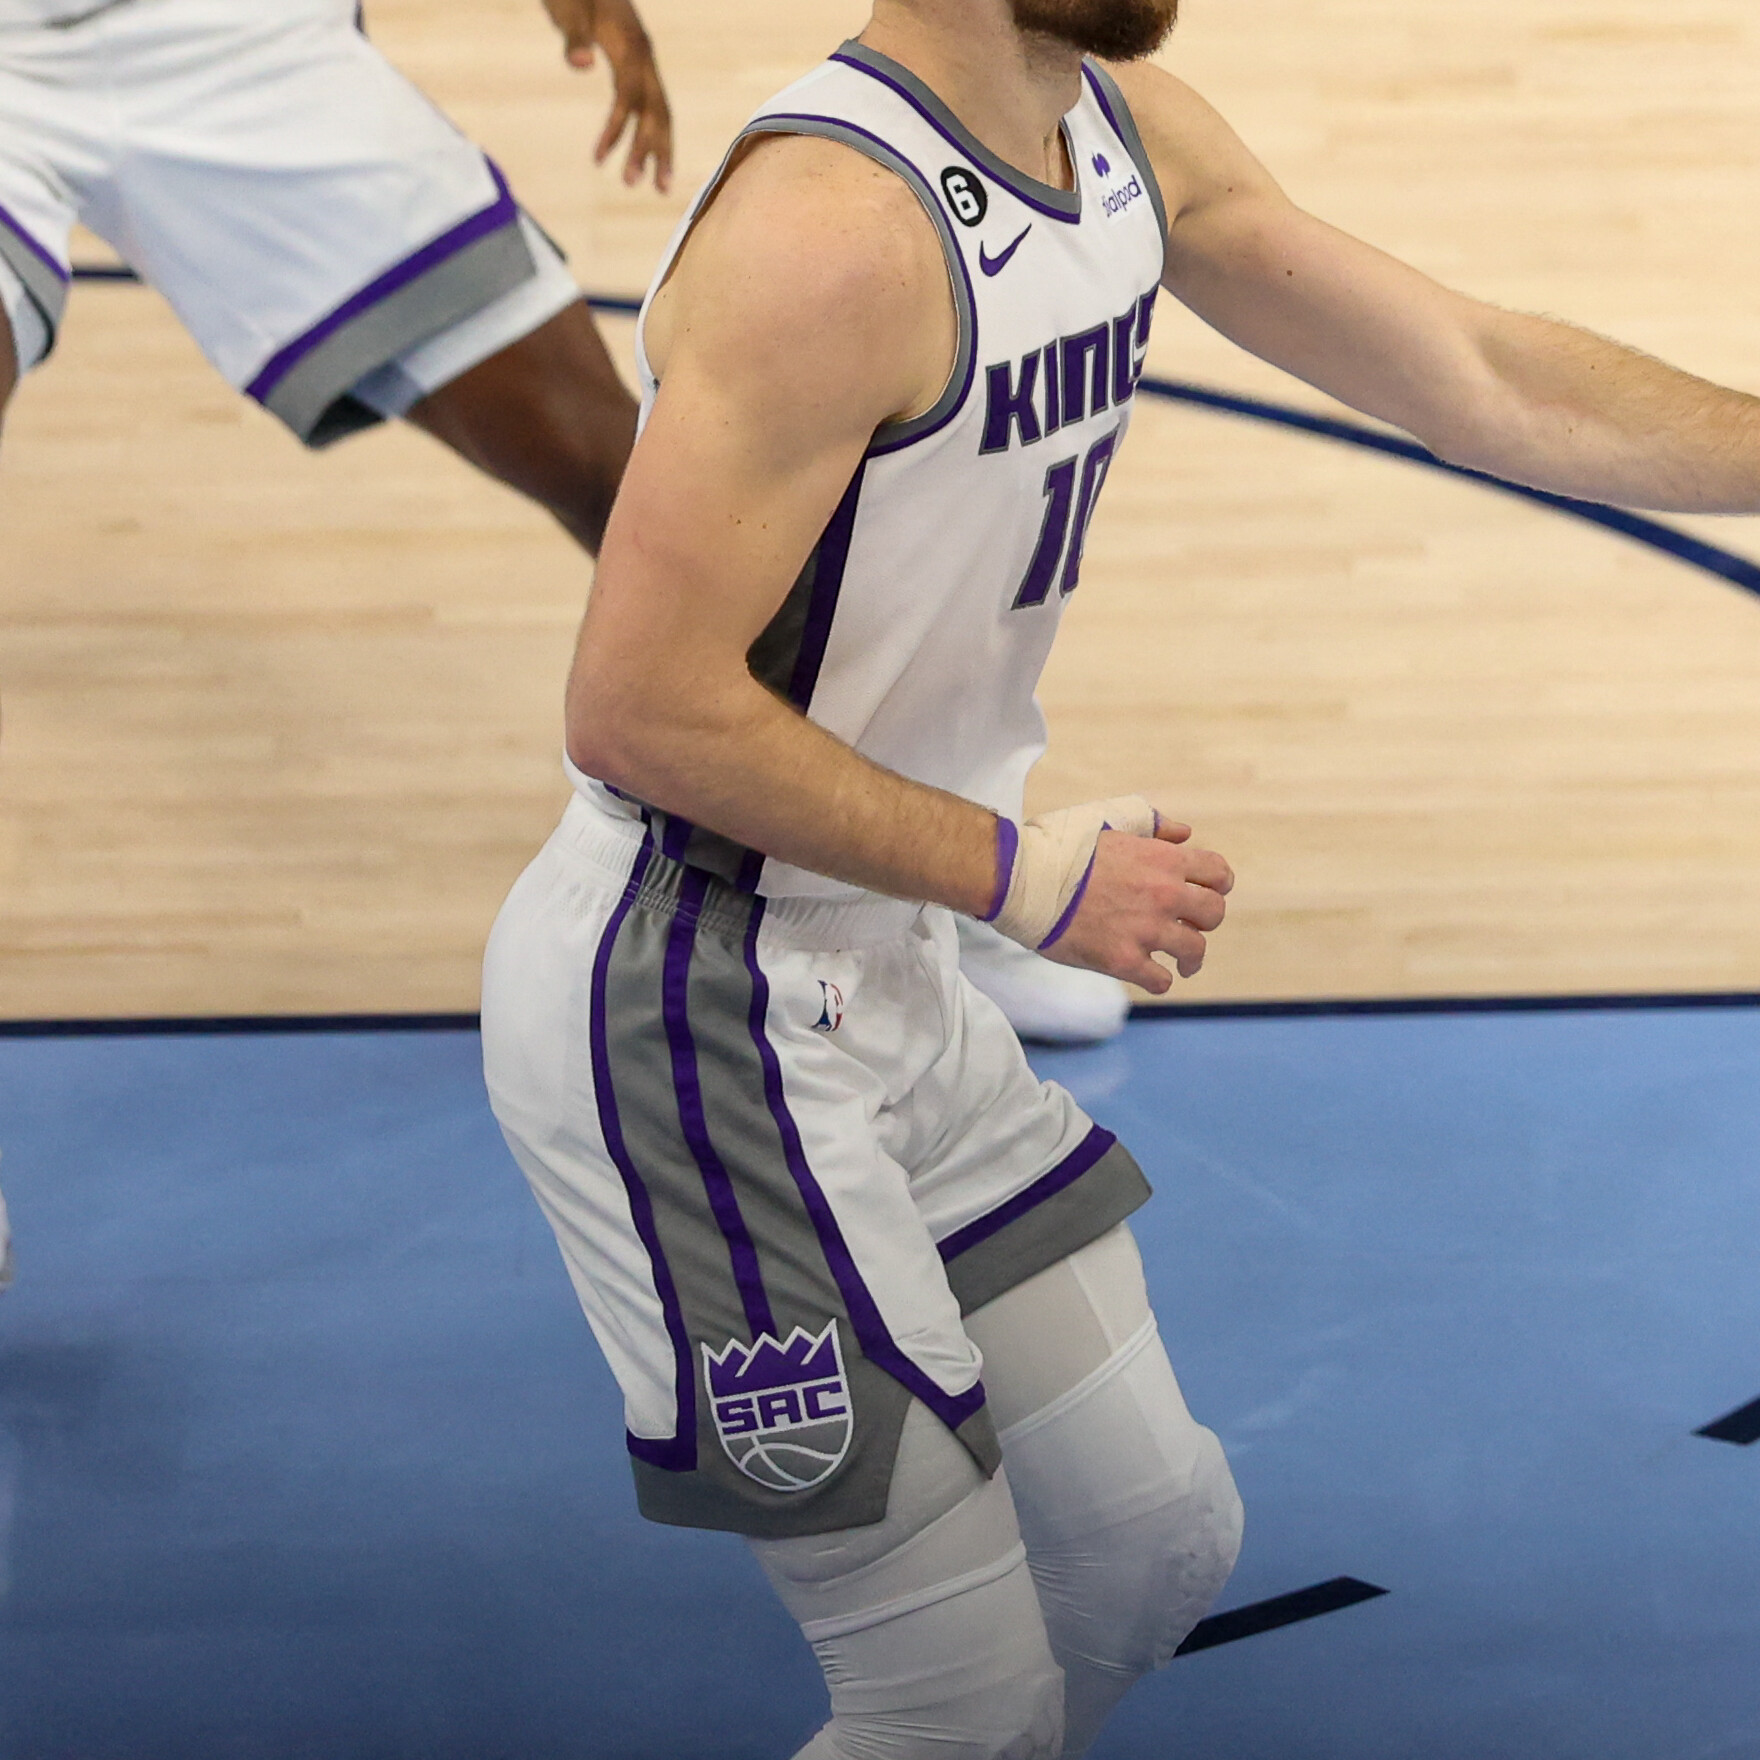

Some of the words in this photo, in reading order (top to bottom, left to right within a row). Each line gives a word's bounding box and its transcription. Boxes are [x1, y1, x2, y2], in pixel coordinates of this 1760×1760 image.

[946, 174, 980, 221] 6
[1010, 421, 1121, 612] 10
[716, 1381, 848, 1435] SAC
